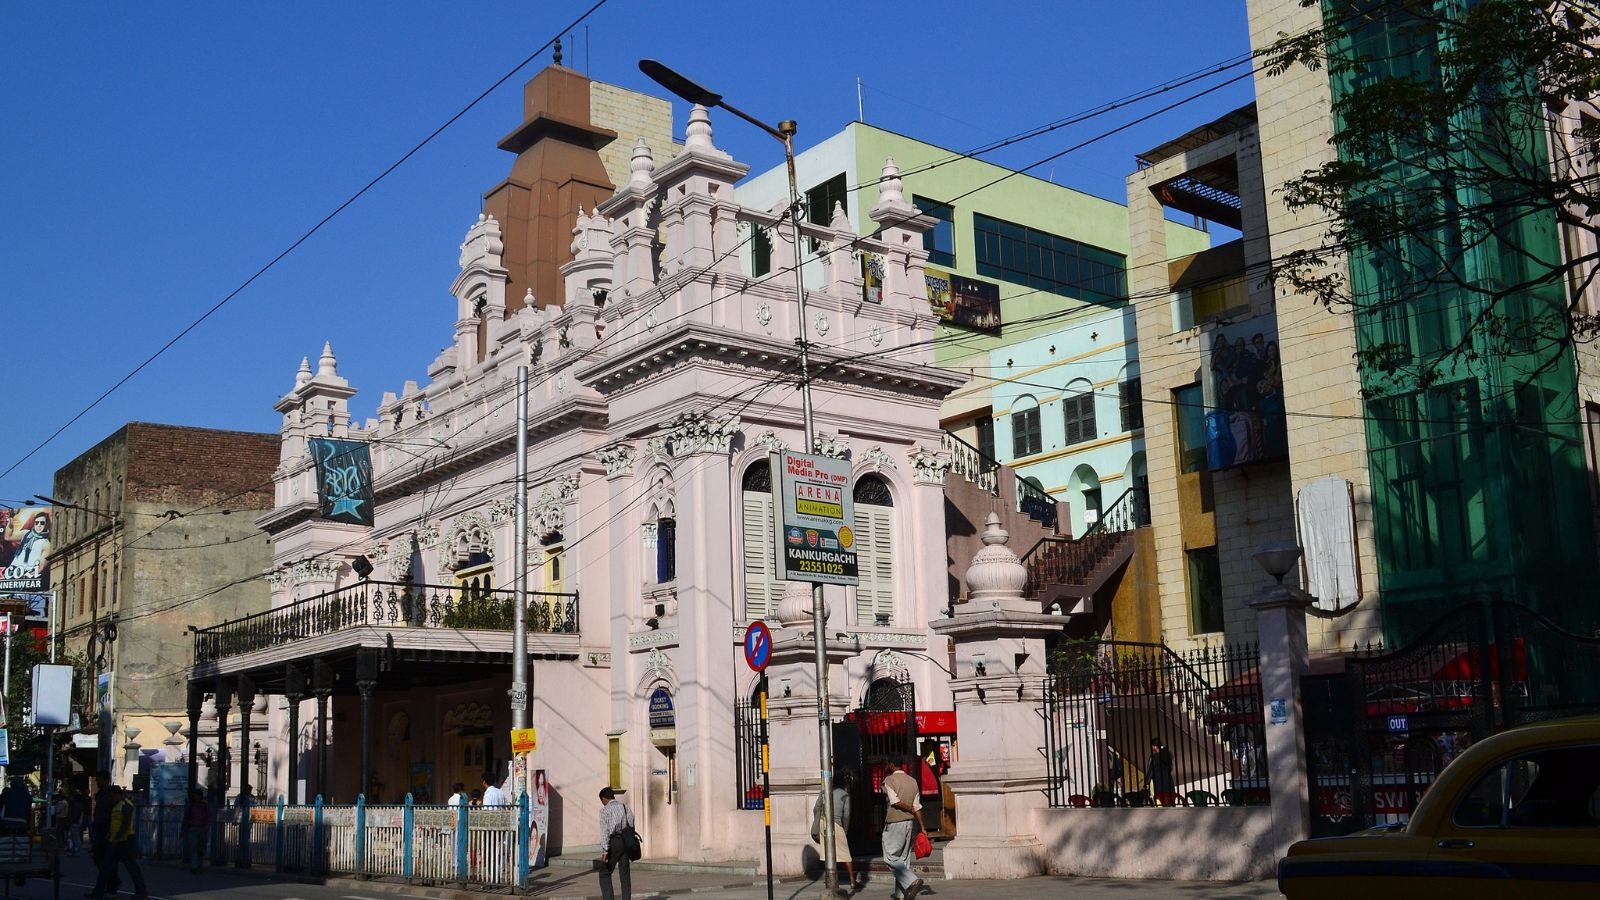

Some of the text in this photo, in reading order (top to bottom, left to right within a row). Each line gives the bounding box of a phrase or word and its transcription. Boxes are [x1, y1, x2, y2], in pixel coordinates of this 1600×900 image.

[787, 456, 815, 468] Digital
[787, 466, 812, 477] Media
[815, 469, 828, 479] Pro
[831, 474, 847, 484] (DMP)
[798, 485, 840, 501] ARENA
[798, 503, 841, 515] ANIMATION
[789, 548, 855, 564] KANKURGACHI
[799, 560, 843, 574] 23551025
[1389, 718, 1406, 730] OUT
